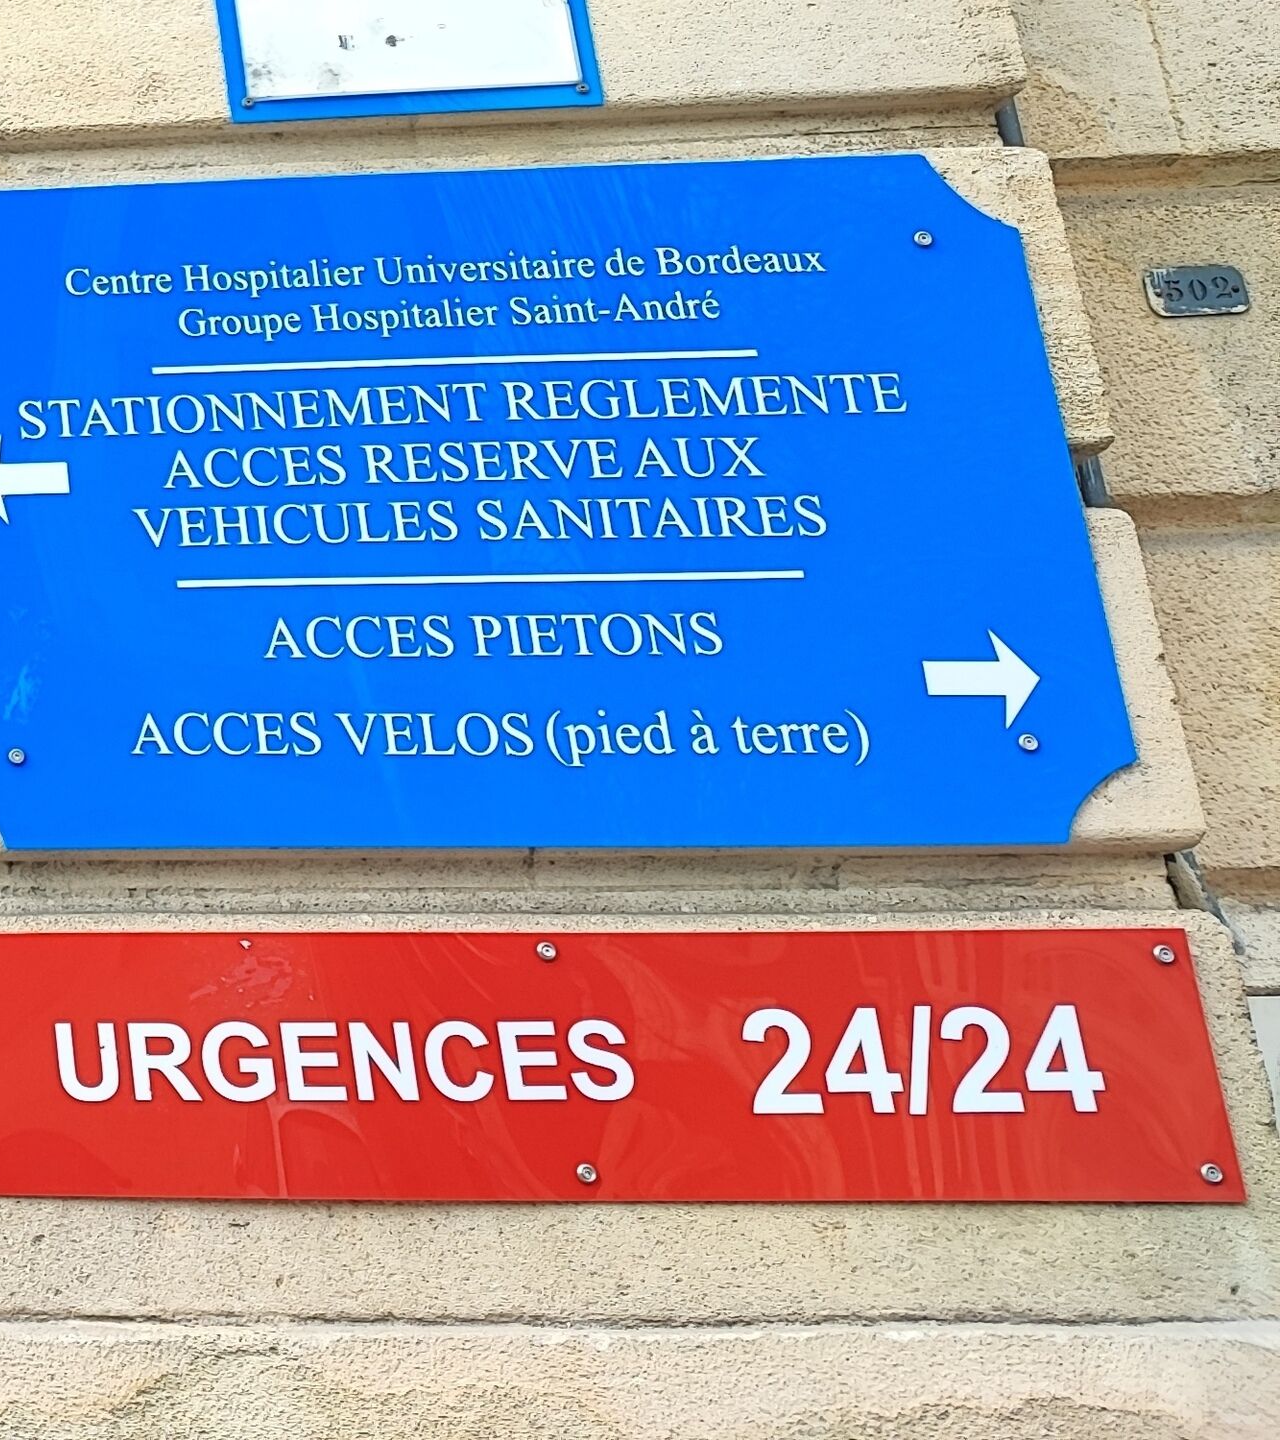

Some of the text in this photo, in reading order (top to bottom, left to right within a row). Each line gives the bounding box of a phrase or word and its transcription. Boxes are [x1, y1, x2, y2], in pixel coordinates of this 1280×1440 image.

[65, 245, 826, 298] Centre Hospitalier Universitaire de Bordeaux
[1164, 275, 1234, 303] 502
[178, 289, 720, 342] Groupe Hospitalier Saint-André
[18, 373, 907, 439] STATIONNEMENT REGLEMENTE
[163, 437, 765, 489] ACCES RESERVE AUX
[132, 494, 827, 548] VEHICULES SANITAIRES
[264, 612, 723, 659] ACCES PIETONS
[131, 709, 870, 767] ACCES VELOS (pied à terre)
[53, 1004, 1107, 1116] URGENCES 24/24
